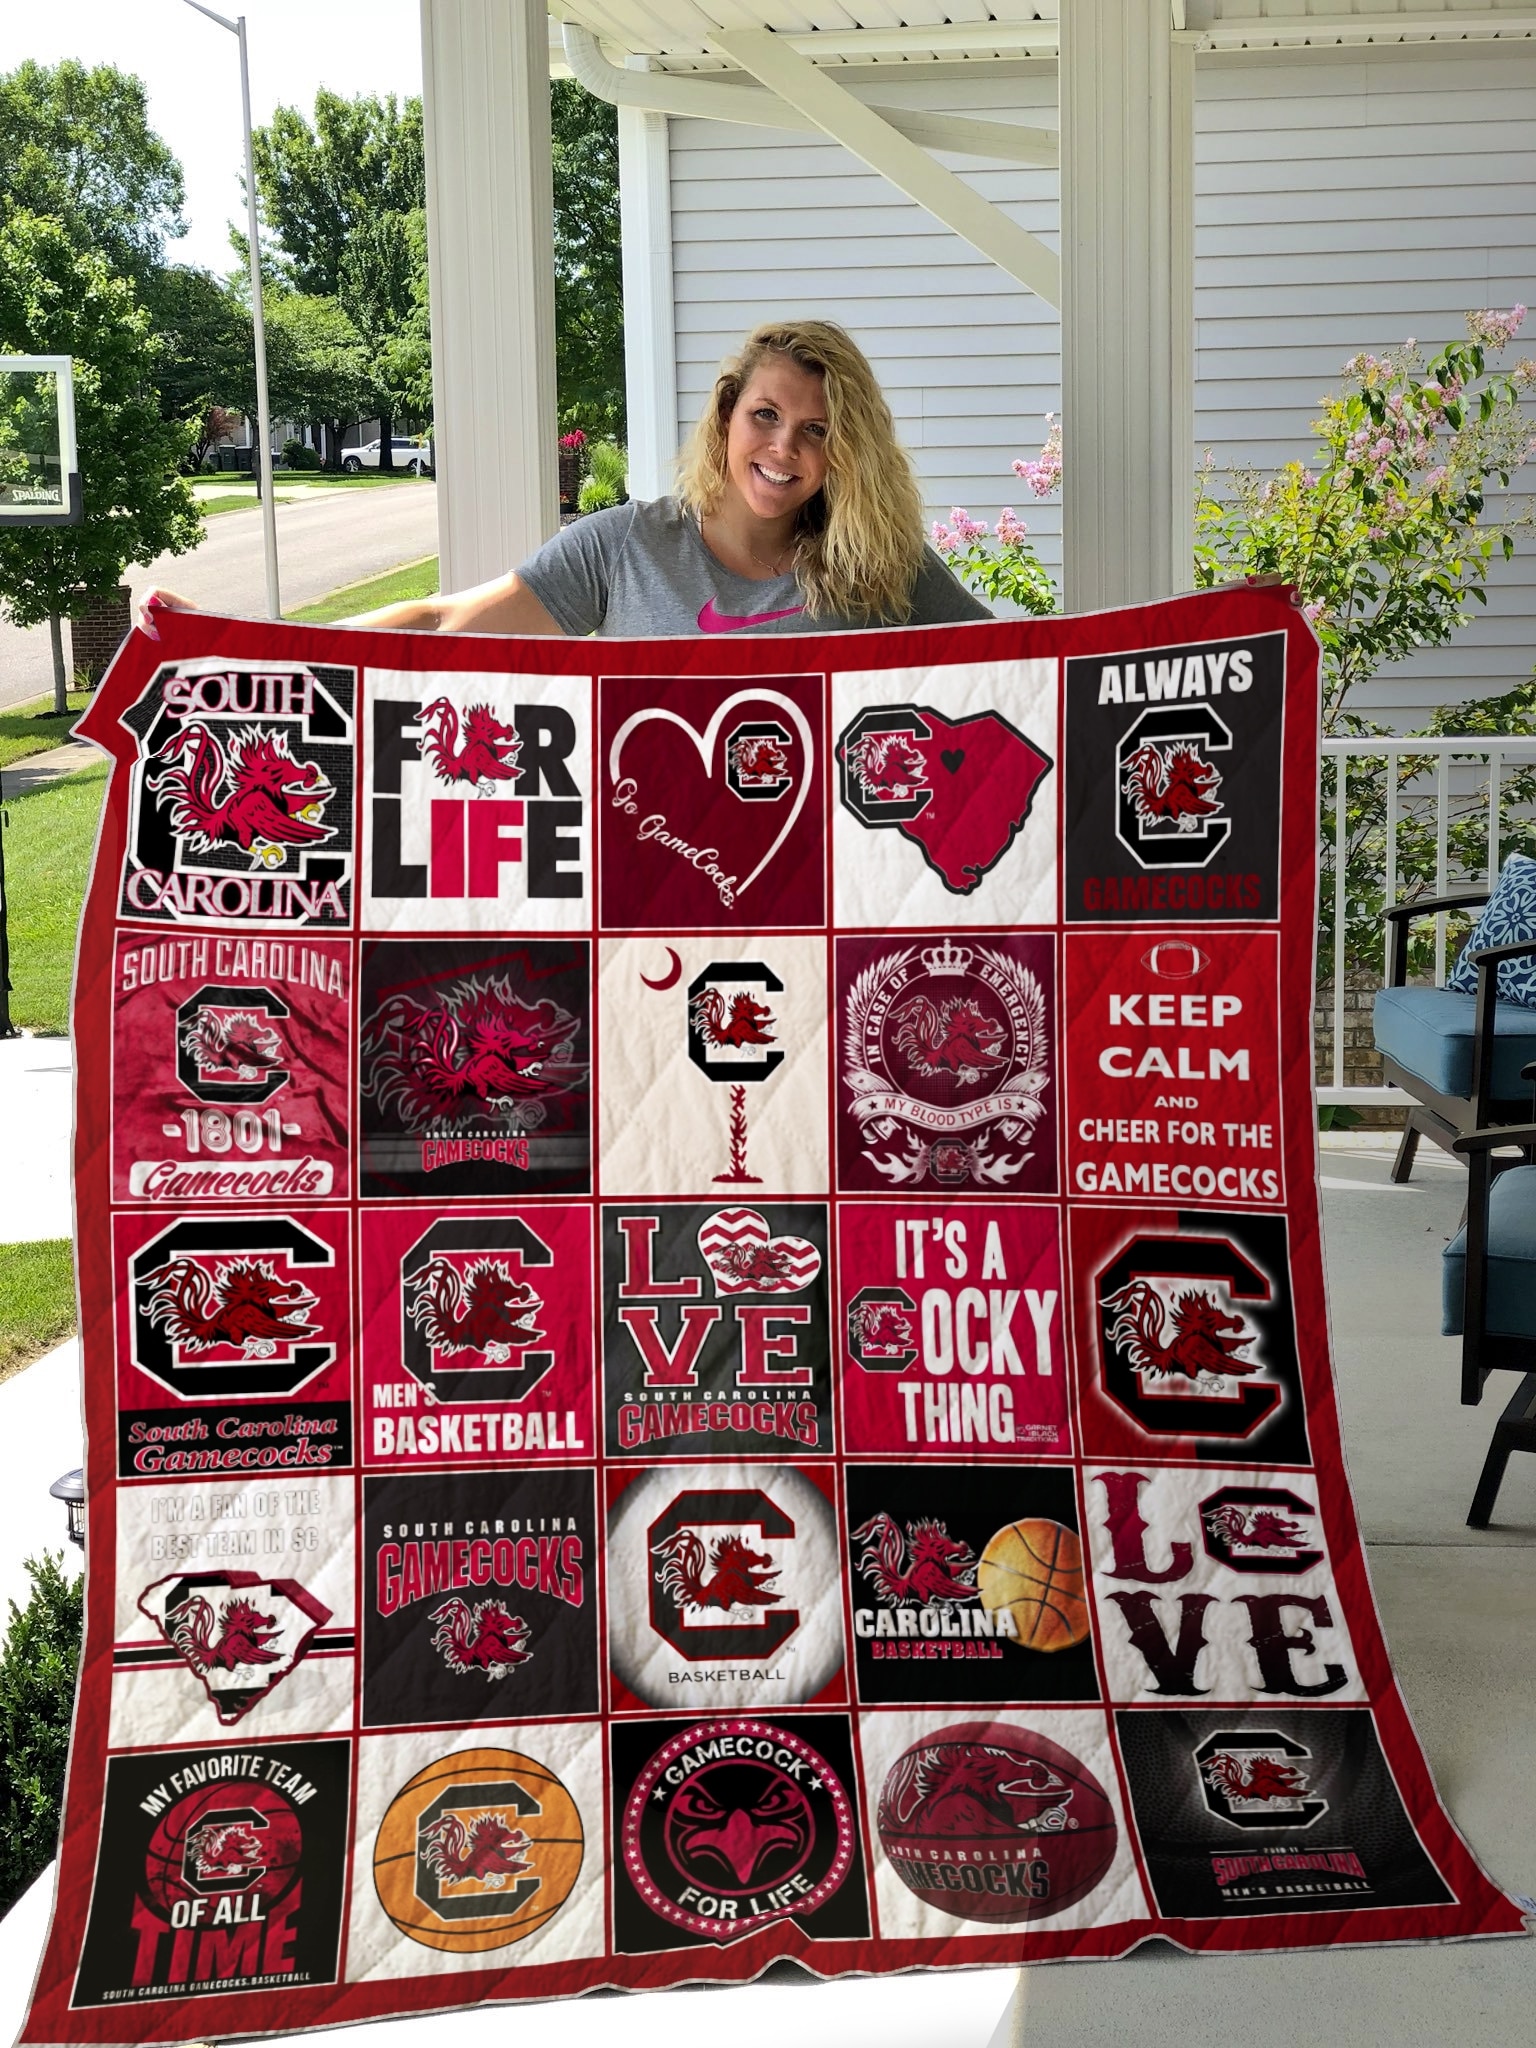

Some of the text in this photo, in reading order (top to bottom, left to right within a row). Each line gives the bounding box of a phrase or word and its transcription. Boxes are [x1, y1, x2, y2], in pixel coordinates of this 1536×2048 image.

[12, 489, 60, 502] SPALDING
[1098, 650, 1253, 705] ALWAYS
[162, 673, 315, 719] SOUTH
[612, 778, 638, 814] Go
[371, 798, 583, 899] LIFE
[127, 869, 348, 919] CAROLINA
[1083, 874, 1261, 911] GAMECOCKS
[122, 939, 344, 999] SOUTH CAROLINA
[866, 964, 1029, 1067] IN CASE OF EMERGENCY
[1109, 994, 1242, 1027] KEEP
[1098, 1046, 1250, 1081] CALM
[885, 1097, 1012, 1126] MY BLOOD TYPE IS
[1154, 1096, 1199, 1109] AND
[425, 1130, 462, 1138] SOUTH
[1078, 1118, 1273, 1148] CHEER FOR THE
[422, 1138, 529, 1173] GAMECOCKS
[143, 1156, 324, 1199] Gamecocks
[1075, 1161, 1279, 1200] GAMECOCKS
[894, 1217, 1007, 1280] IT'S A
[372, 1382, 436, 1408] MEN'S
[624, 1390, 810, 1402] SOUTH CAROLINA
[898, 1381, 1015, 1443] THING
[128, 1414, 338, 1443] South Carolina
[373, 1411, 584, 1456] BASKETBALL
[617, 1402, 819, 1449] GAMECOCKS
[134, 1437, 333, 1472] Gamecocks
[151, 1490, 320, 1523] I'M A FAN OF THE
[151, 1527, 318, 1560] BEST TEAM IN SC
[383, 1517, 577, 1539] SOUTH CAROLINA
[376, 1534, 584, 1618] GAMECOCKS
[855, 1608, 1018, 1638] CAROLINA
[871, 1641, 1003, 1659] BASKETBALL
[668, 1669, 785, 1684] BASKETBALL
[665, 1737, 810, 1785] GAMECOCK
[139, 1755, 318, 1817] MY FAVORITE TEAM
[930, 1847, 1042, 1861] CAROLINA
[1211, 1852, 1367, 1886] SOUTH CAROLINA
[677, 1873, 815, 1919] FOR LIFE
[1275, 1881, 1371, 1894] BASKETBALL
[171, 1894, 266, 1929] OF ALL
[130, 1884, 303, 1987] TIME
[102, 1989, 134, 2000] SOUTH
[138, 1984, 186, 1996] CAROLINA
[251, 1972, 311, 1985] BASKETBALL
